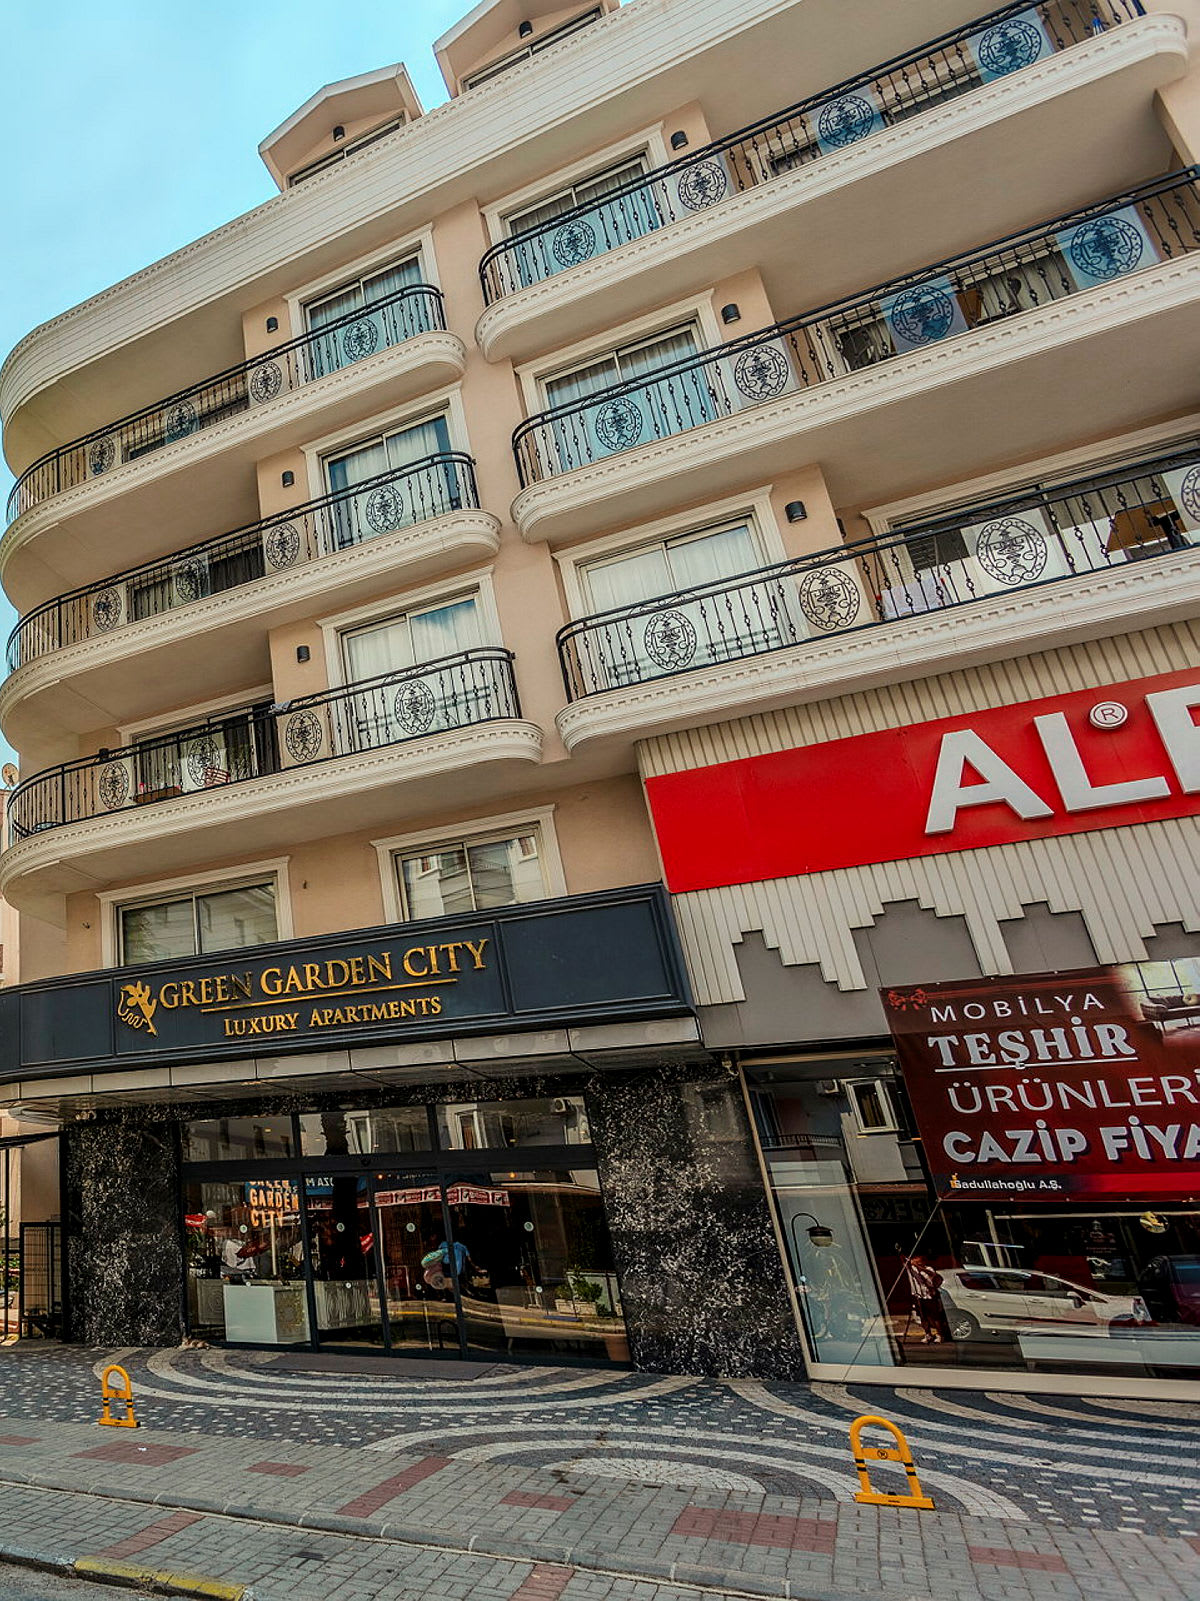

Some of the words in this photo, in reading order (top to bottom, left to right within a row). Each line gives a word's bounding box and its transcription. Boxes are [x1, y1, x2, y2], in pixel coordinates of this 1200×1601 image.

[159, 971, 252, 1009] GREEN
[260, 952, 392, 996] GARDEN
[403, 938, 489, 977] CITY
[224, 1012, 299, 1037] LUXURY
[309, 996, 442, 1028] APARTMENTS
[930, 993, 1105, 1023] MOBİLYA
[927, 1016, 1136, 1070] TEŞHİR
[943, 1119, 1088, 1163] CAZİP
